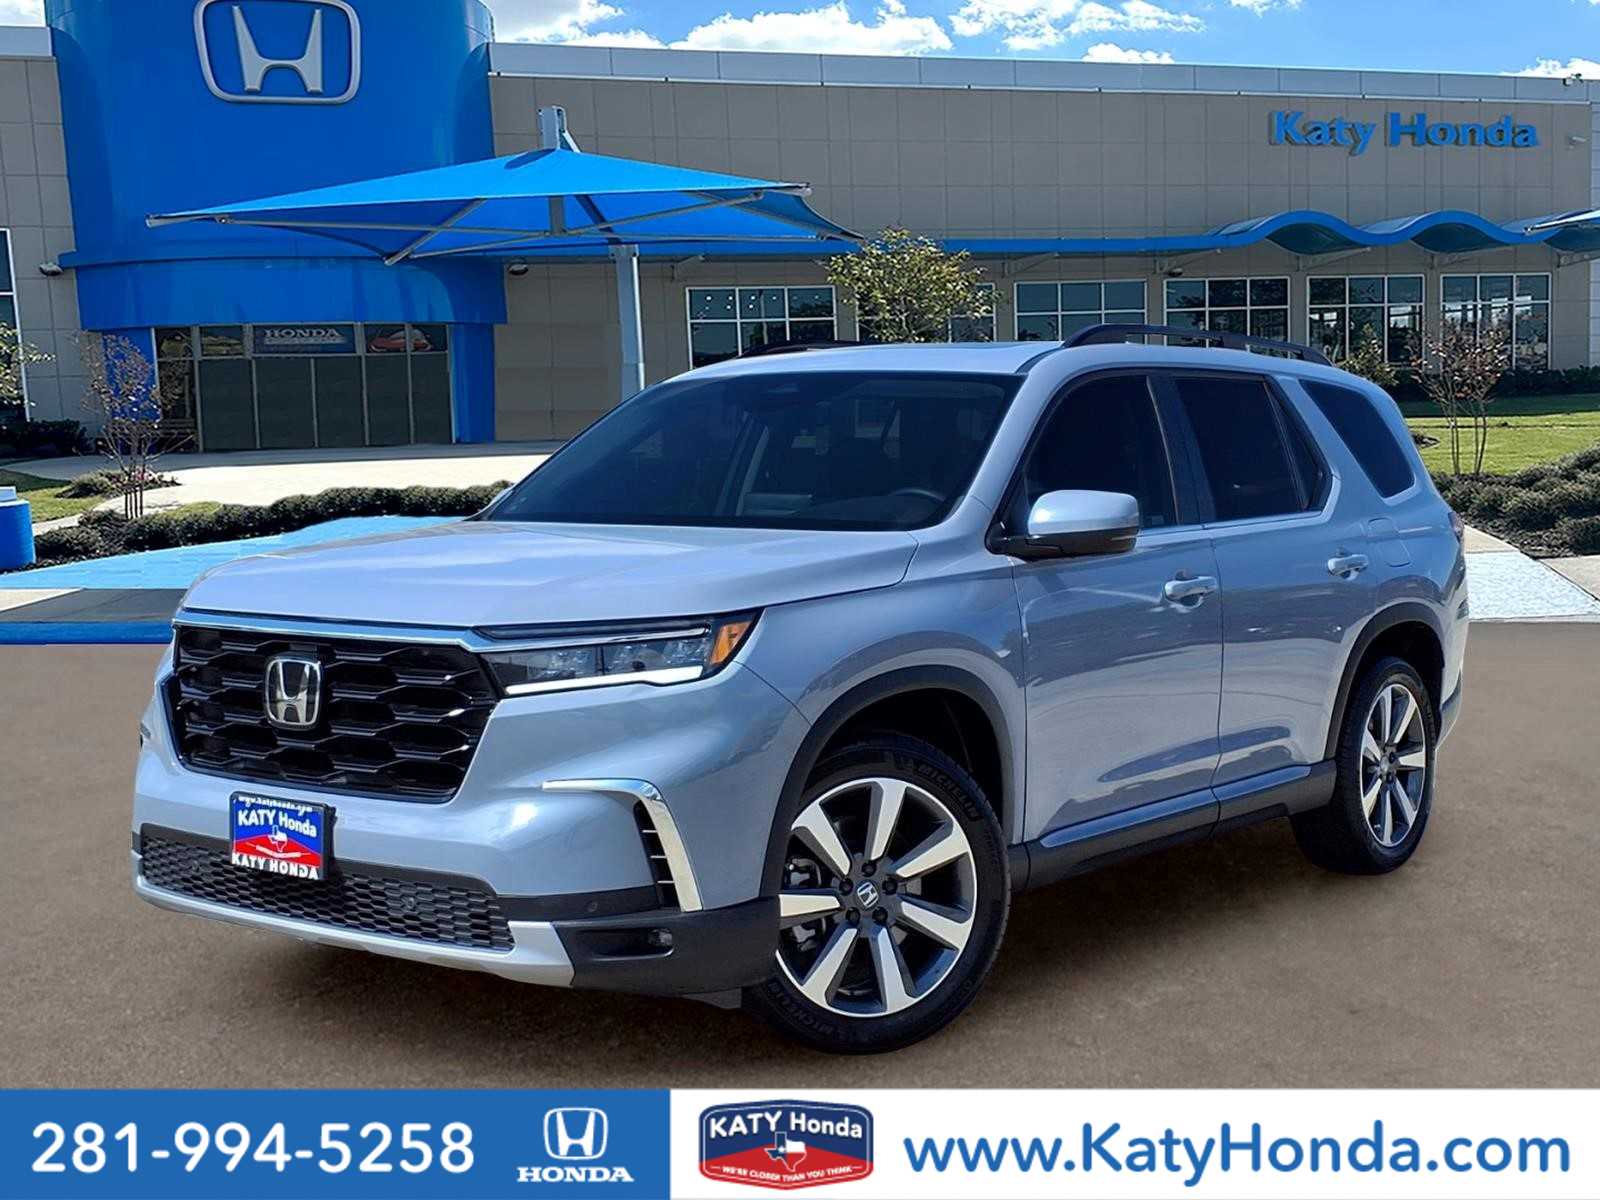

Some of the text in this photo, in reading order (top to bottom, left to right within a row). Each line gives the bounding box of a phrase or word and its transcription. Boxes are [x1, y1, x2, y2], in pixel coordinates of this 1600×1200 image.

[1273, 112, 1539, 155] Katy Honda
[264, 328, 342, 338] HONDA
[238, 809, 317, 838] KATY Honda
[231, 852, 319, 880] KATY HONDA
